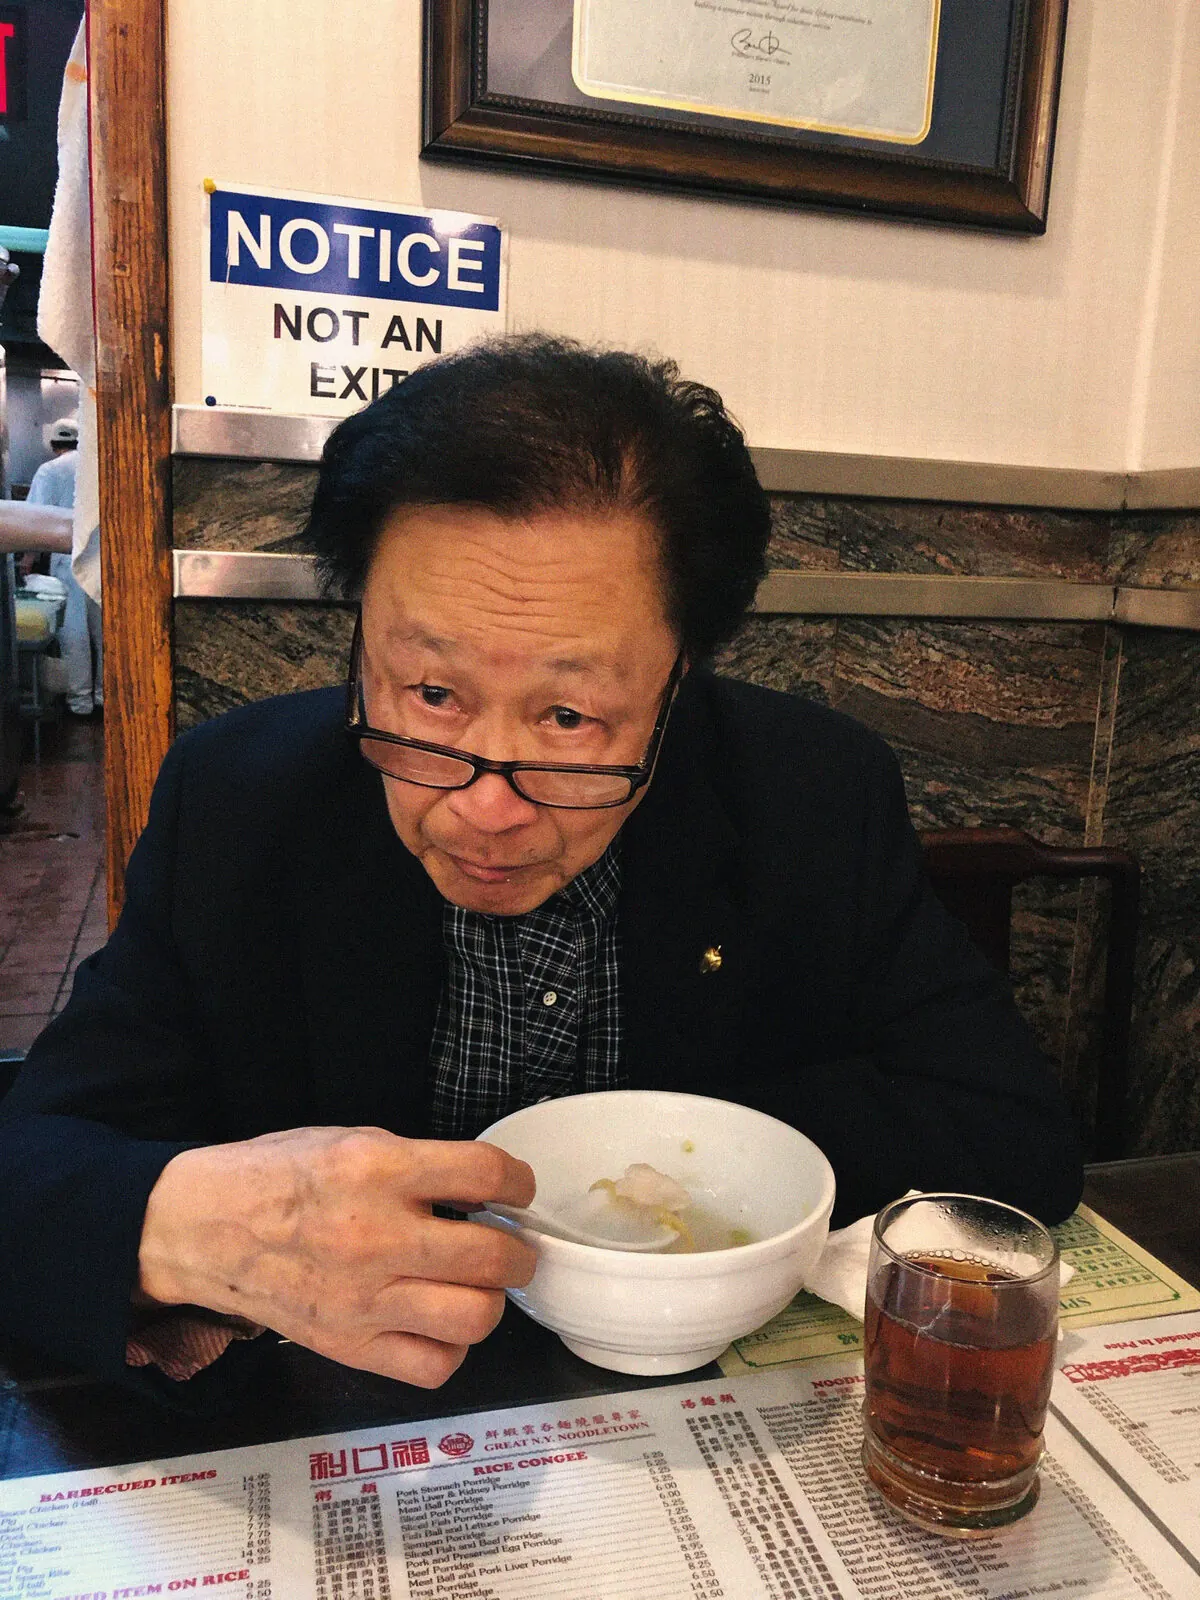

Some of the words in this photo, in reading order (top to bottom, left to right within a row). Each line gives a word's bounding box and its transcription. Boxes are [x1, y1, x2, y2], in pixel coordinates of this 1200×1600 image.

[749, 74, 771, 85] 2015
[227, 209, 486, 293] NOTICE
[273, 303, 369, 346] NOT
[380, 315, 442, 354] AN
[811, 1376, 865, 1389] NOODL
[484, 1439, 529, 1452] GREAT
[532, 1435, 556, 1445] N.Y.
[558, 1421, 650, 1441] NOODLETOWN
[309, 1437, 431, 1481] 利口福
[473, 1461, 515, 1476] RICE
[517, 1451, 588, 1470] CONGEE
[40, 1478, 157, 1503] BARBECUED
[161, 1470, 218, 1488] ITEMS
[396, 1489, 418, 1498] Pork
[420, 1482, 461, 1494] Stomach
[463, 1475, 501, 1487] Porridge
[397, 1496, 419, 1506] Pork
[422, 1493, 445, 1502] Liver
[458, 1485, 490, 1496] Kidney
[492, 1480, 531, 1491] Porridge
[406, 1559, 429, 1569] Pork
[432, 1556, 450, 1565] and
[453, 1546, 499, 1561] Preserved
[501, 1543, 521, 1553] Egg
[523, 1537, 563, 1549] Porridge
[167, 1576, 197, 1592] ON
[202, 1569, 250, 1587] RICE
[407, 1568, 430, 1579] Beef
[433, 1561, 474, 1574] Porridge
[408, 1578, 433, 1588] Meat
[436, 1574, 455, 1583] Ball
[458, 1571, 476, 1579] and
[479, 1566, 502, 1575] Pork
[505, 1561, 529, 1571] Liver
[531, 1554, 573, 1567] Porridge
[436, 1579, 478, 1592] Porridge
